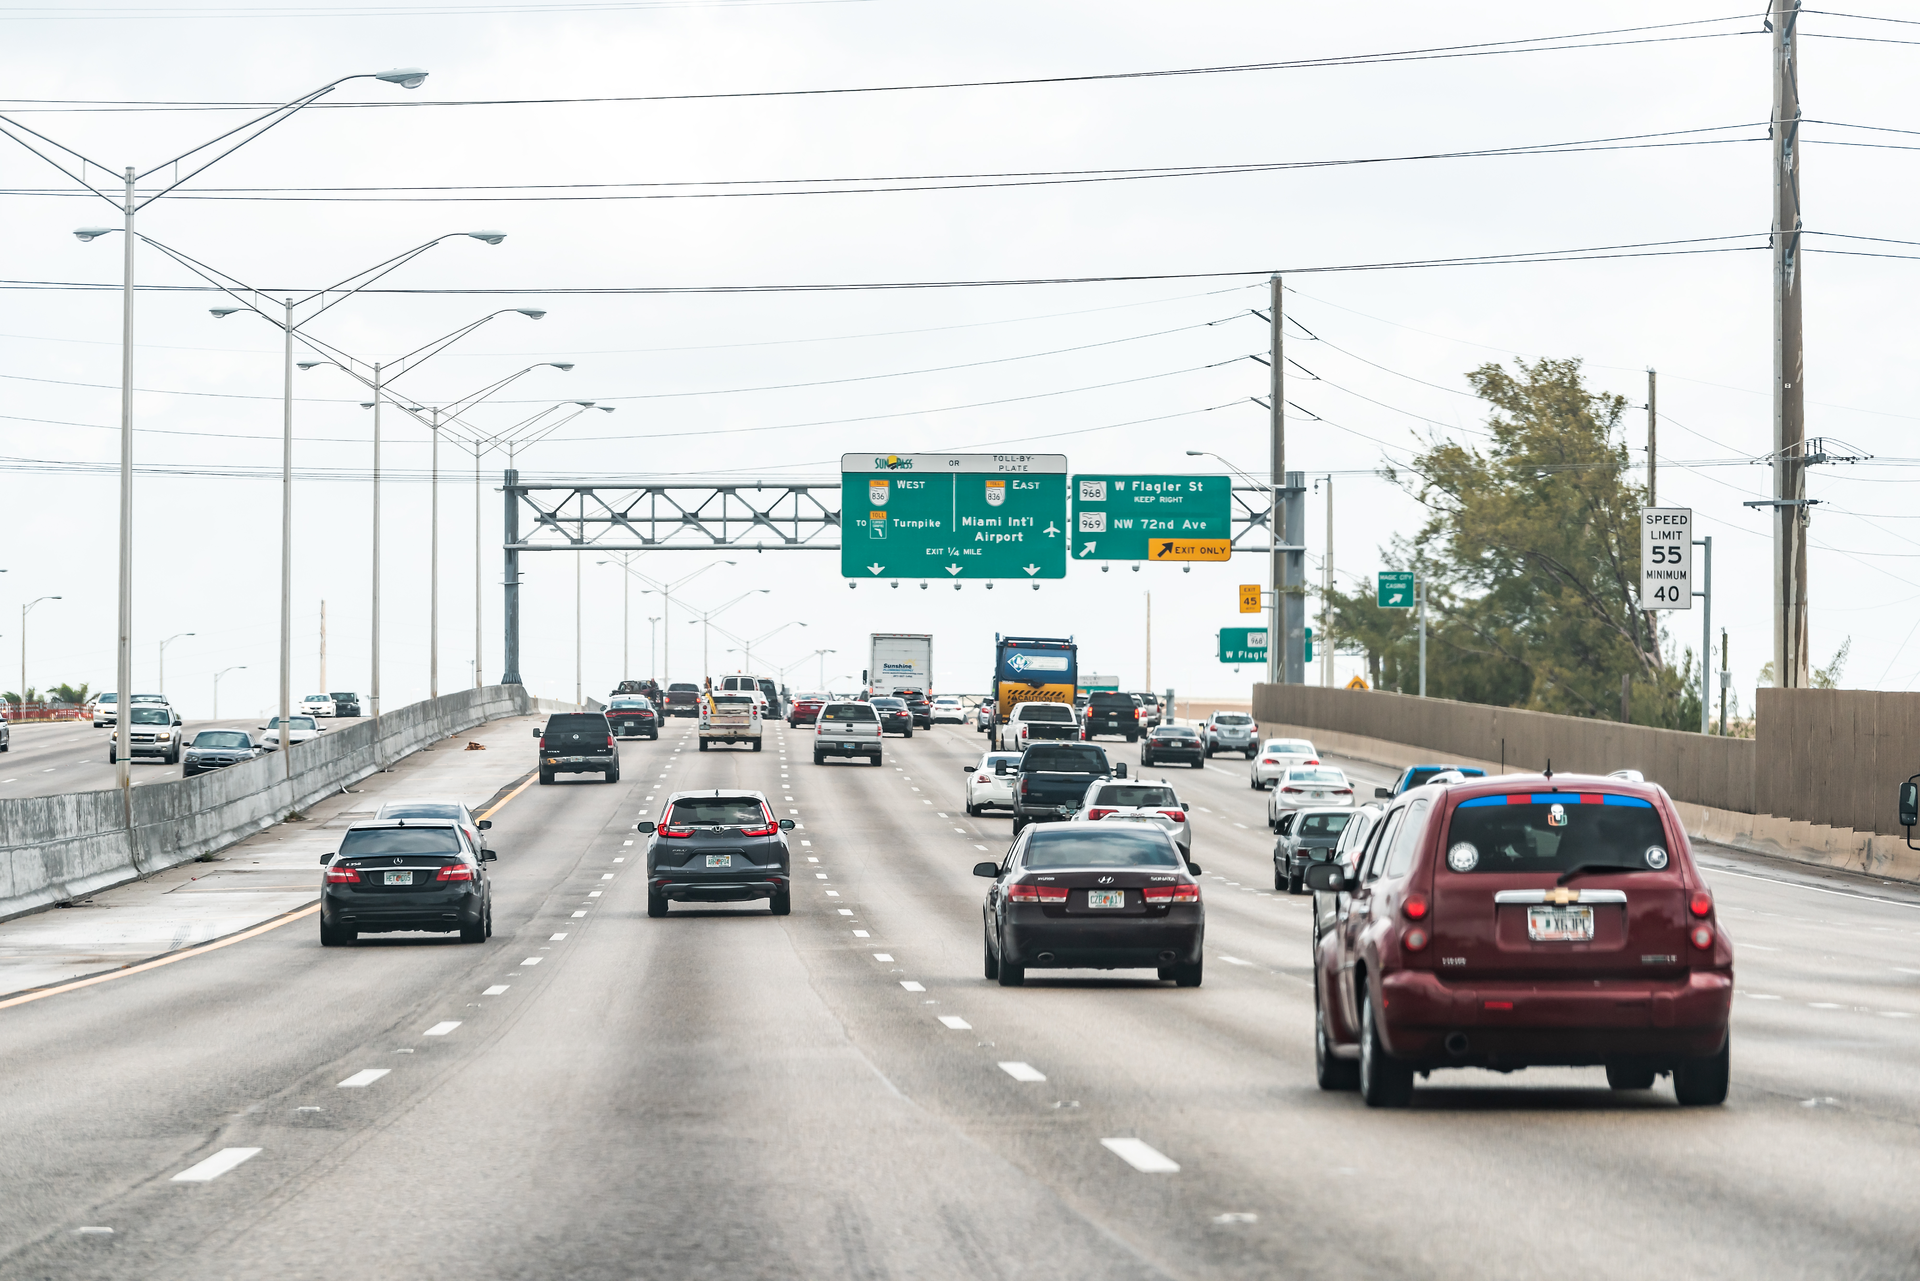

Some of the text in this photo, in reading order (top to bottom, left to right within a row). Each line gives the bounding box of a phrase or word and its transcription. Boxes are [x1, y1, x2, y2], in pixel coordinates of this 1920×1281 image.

[896, 480, 925, 489] WEST
[1012, 480, 1040, 490] EAST
[1114, 481, 1203, 494] W Flagler St
[871, 492, 885, 500] 836
[987, 493, 1001, 501] 836
[1082, 488, 1101, 498] 968
[856, 519, 867, 527] TO
[893, 518, 941, 529] Turnpike
[962, 516, 1034, 527] Miami Int'l
[1081, 519, 1101, 529] 969
[1114, 519, 1207, 529] NW 72nd Ave
[1646, 515, 1688, 525] SPEED
[974, 531, 1024, 544] Airport
[1650, 530, 1683, 540] LIMIT
[963, 548, 982, 556] MILE
[1175, 546, 1227, 555] EXIT ONLY
[1652, 545, 1682, 564] 55
[1646, 570, 1687, 580] MINIMUM
[1653, 586, 1680, 602] 40
[1243, 597, 1257, 606] 45
[1225, 651, 1234, 659] W
[1017, 695, 1053, 703] CAUTION
